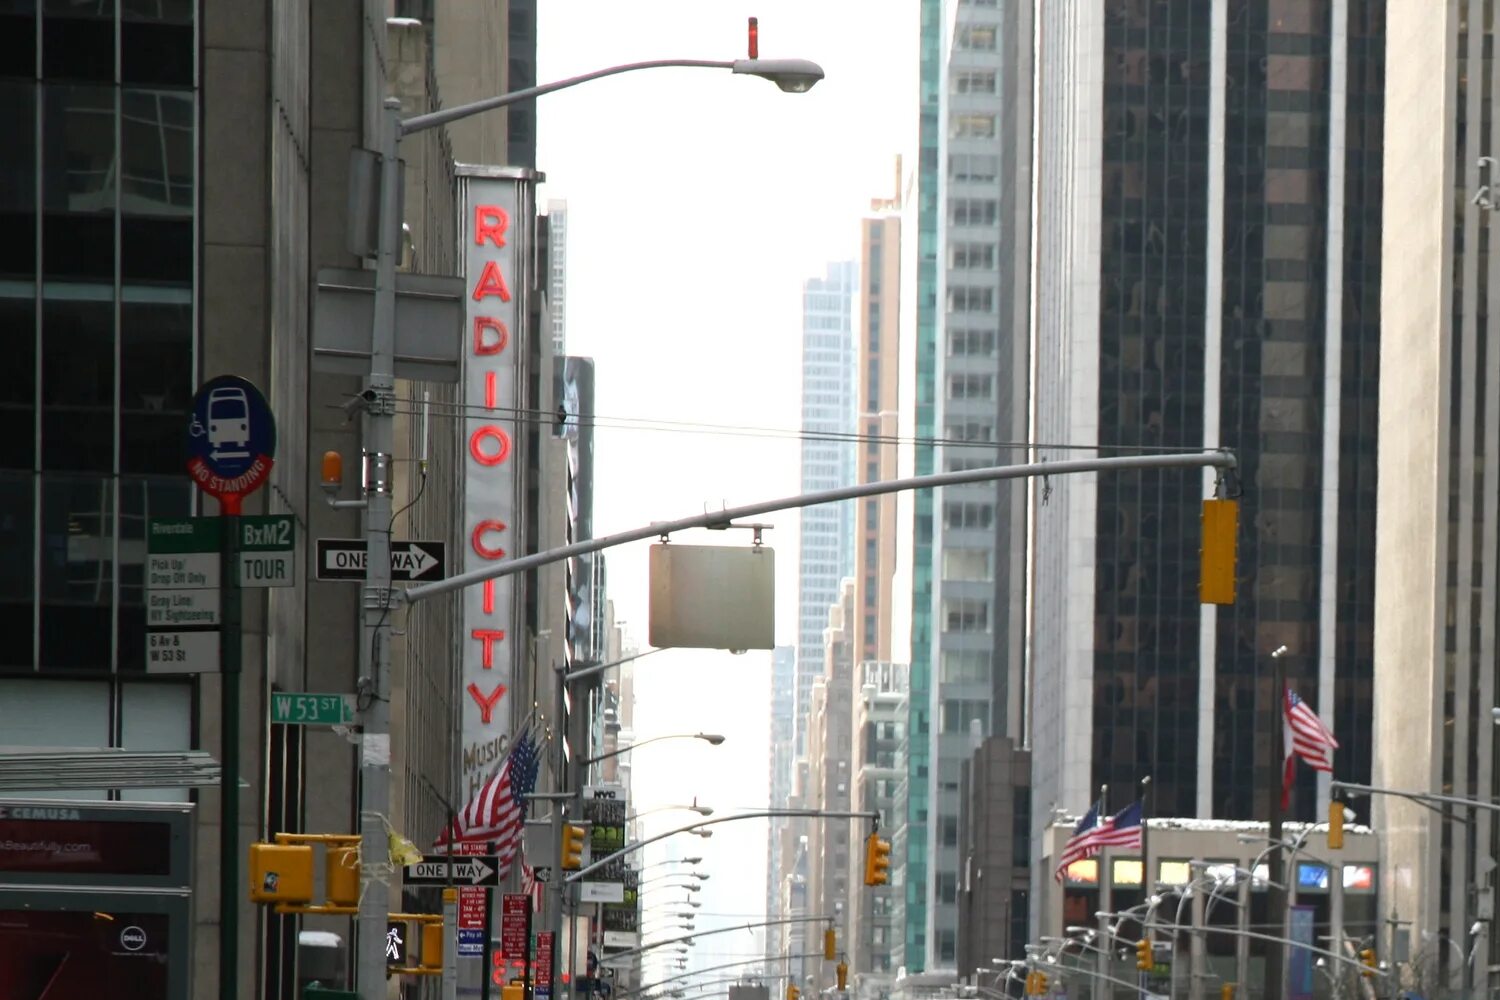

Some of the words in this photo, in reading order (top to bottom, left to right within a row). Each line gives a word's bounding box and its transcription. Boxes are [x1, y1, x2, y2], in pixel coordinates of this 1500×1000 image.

[469, 204, 511, 467] RADIO
[191, 461, 209, 482] NO
[209, 459, 265, 492] STANDING
[244, 519, 290, 545] BxM2
[152, 559, 169, 570] Pick
[336, 552, 368, 568] ONE
[391, 553, 426, 569] WAY
[244, 559, 285, 579] TOUR
[151, 573, 171, 584] Drop
[173, 572, 186, 583] Off
[187, 572, 207, 585] Only
[151, 596, 171, 609] Gray
[151, 610, 163, 621] NY
[165, 609, 215, 622] Sightseeing
[467, 519, 508, 724] CITY
[150, 635, 157, 647] 6
[159, 635, 171, 646] Av
[173, 635, 180, 646] &
[150, 650, 160, 661] W
[162, 650, 174, 661] 53
[175, 650, 186, 661] St
[276, 697, 292, 720] W
[296, 697, 319, 720] 53
[321, 697, 337, 710] ST
[593, 790, 616, 799] NYC
[12, 807, 81, 820] CEMUSA
[416, 865, 444, 877] ONE
[456, 865, 485, 878] WAY
[123, 934, 144, 942] DELL
